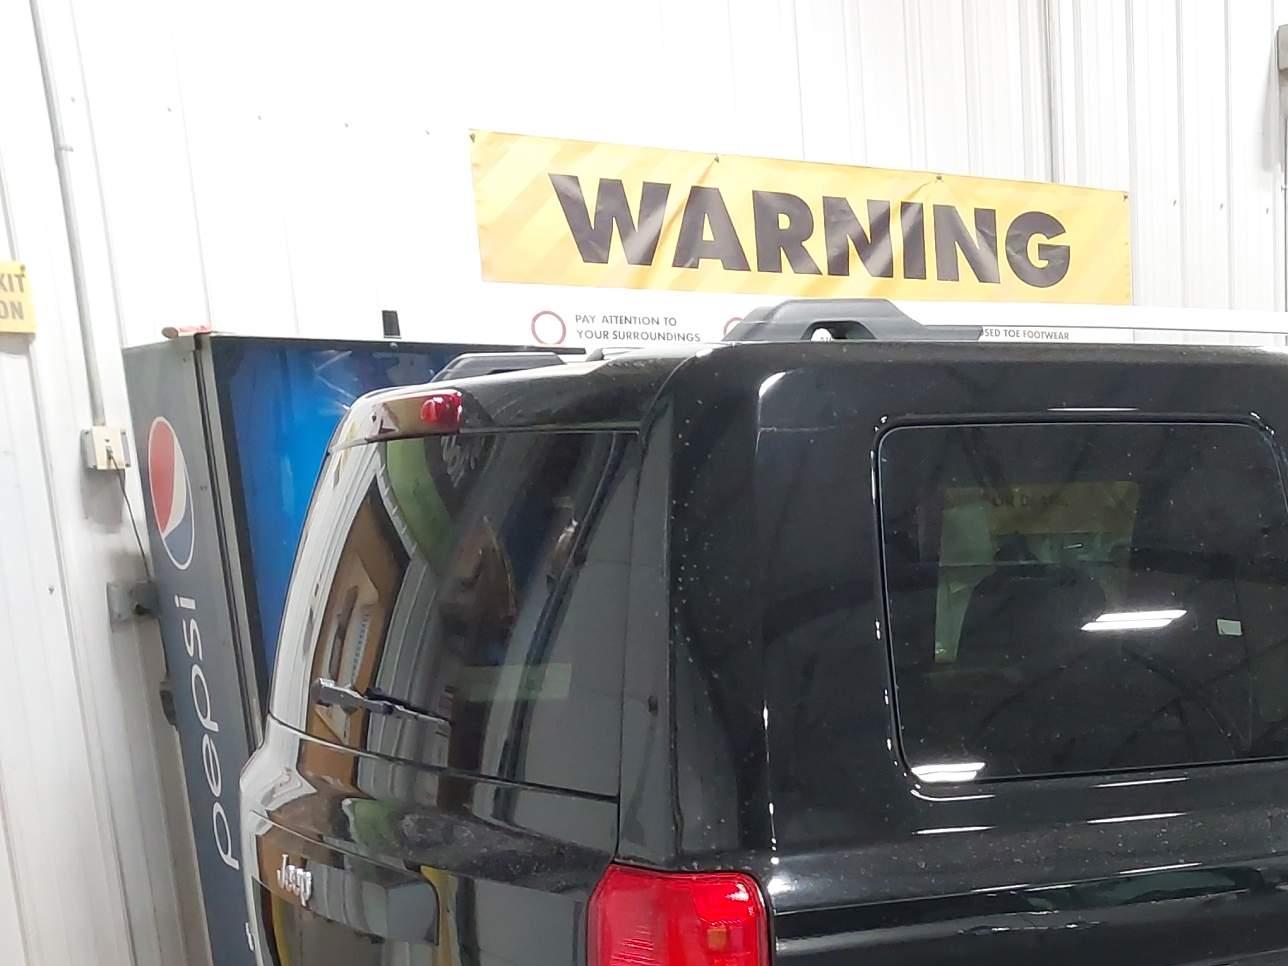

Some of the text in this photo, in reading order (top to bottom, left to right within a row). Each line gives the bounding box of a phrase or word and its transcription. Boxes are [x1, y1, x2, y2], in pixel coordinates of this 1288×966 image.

[548, 173, 1071, 288] WARNING
[575, 314, 677, 327] PAY ATTENTION TO
[577, 329, 701, 342] YOUR SURROUNDINGS
[981, 328, 1070, 340] SED TOE FOOTWEAR
[175, 595, 240, 871] pepsi
[277, 854, 312, 906] Jeep
